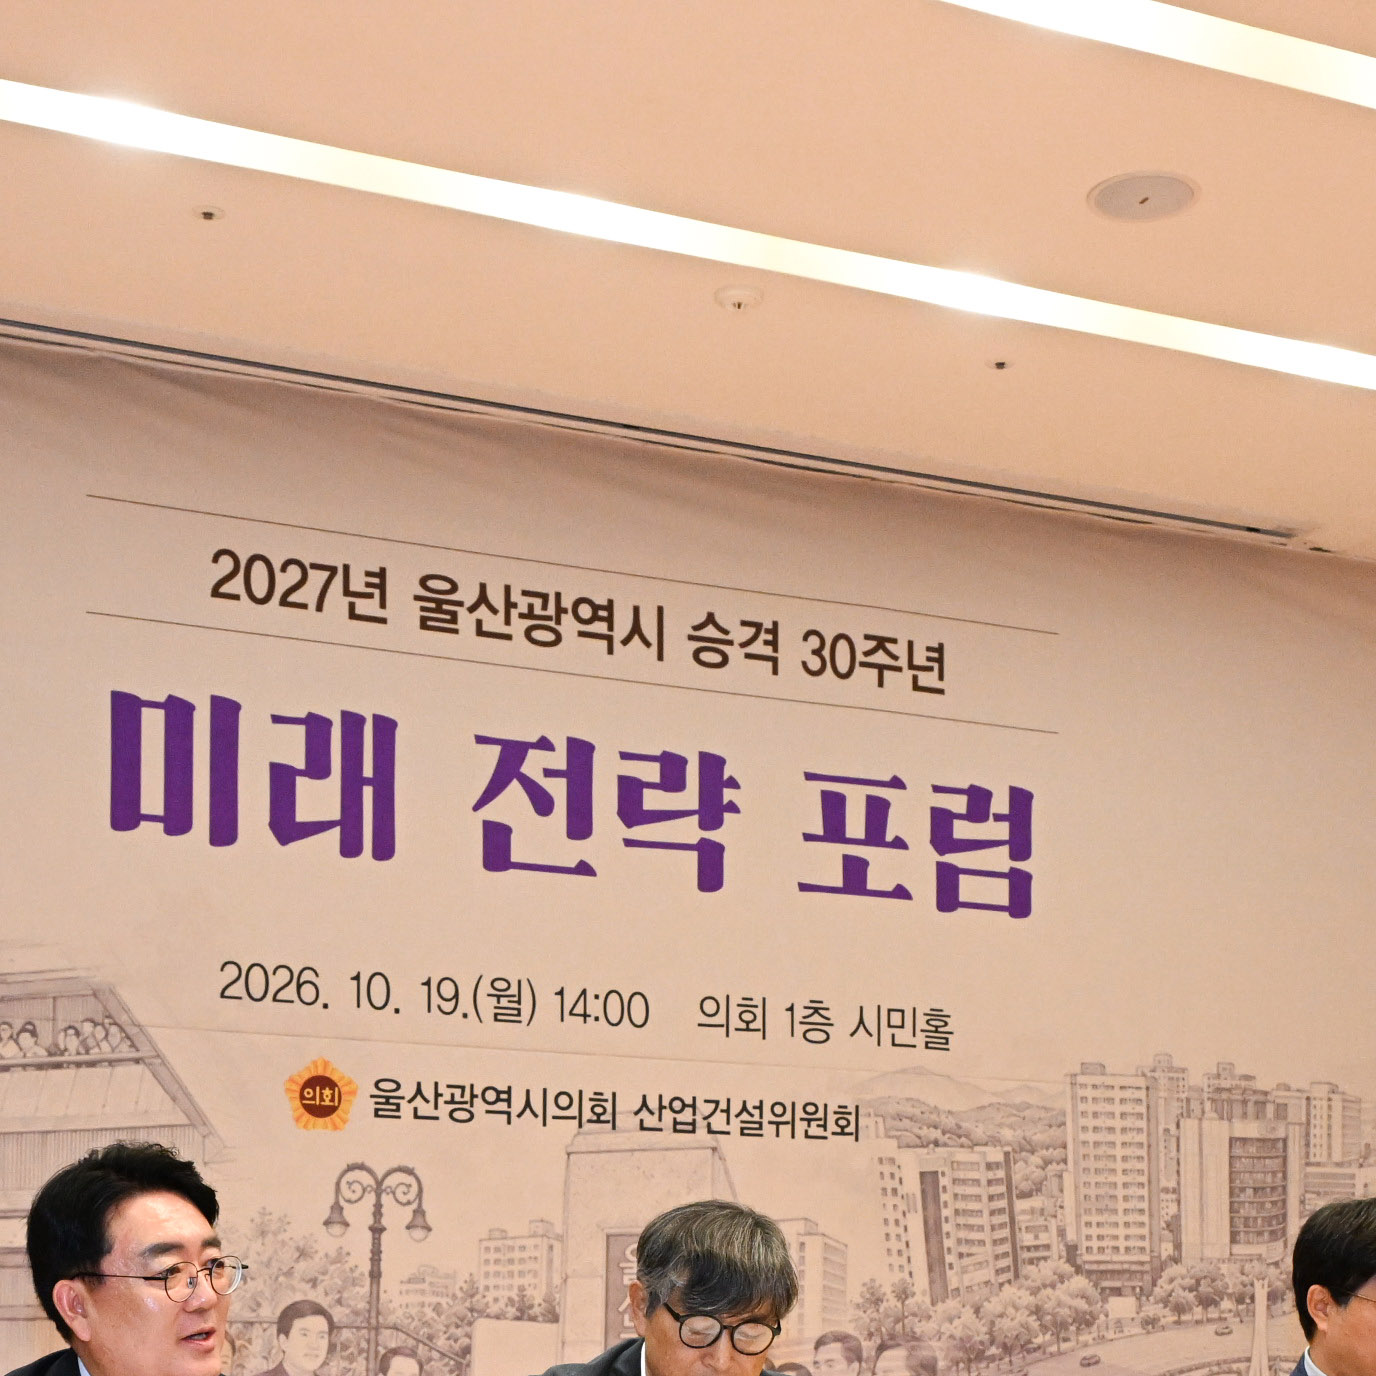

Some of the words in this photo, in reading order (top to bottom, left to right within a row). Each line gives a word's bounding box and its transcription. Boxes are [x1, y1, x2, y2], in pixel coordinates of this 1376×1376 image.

[210, 548, 389, 625] 2027년
[413, 571, 667, 661] 울산광역시
[687, 610, 781, 677] 승격
[800, 628, 948, 696] 30주년
[109, 689, 399, 862] 미래
[472, 731, 742, 894] 전략
[797, 770, 1035, 920] 포럼
[219, 959, 329, 1009] 2026.
[349, 970, 401, 1014] 10.
[421, 973, 537, 1027] 19.(월)
[554, 986, 650, 1029] 14:00
[697, 994, 768, 1041] 의회
[785, 1000, 835, 1043] 1층
[848, 1002, 954, 1053] 시민홀
[302, 1086, 339, 1106] 의회
[369, 1076, 618, 1131] 울산광역시의회
[633, 1092, 861, 1142] 산업건설위원회
